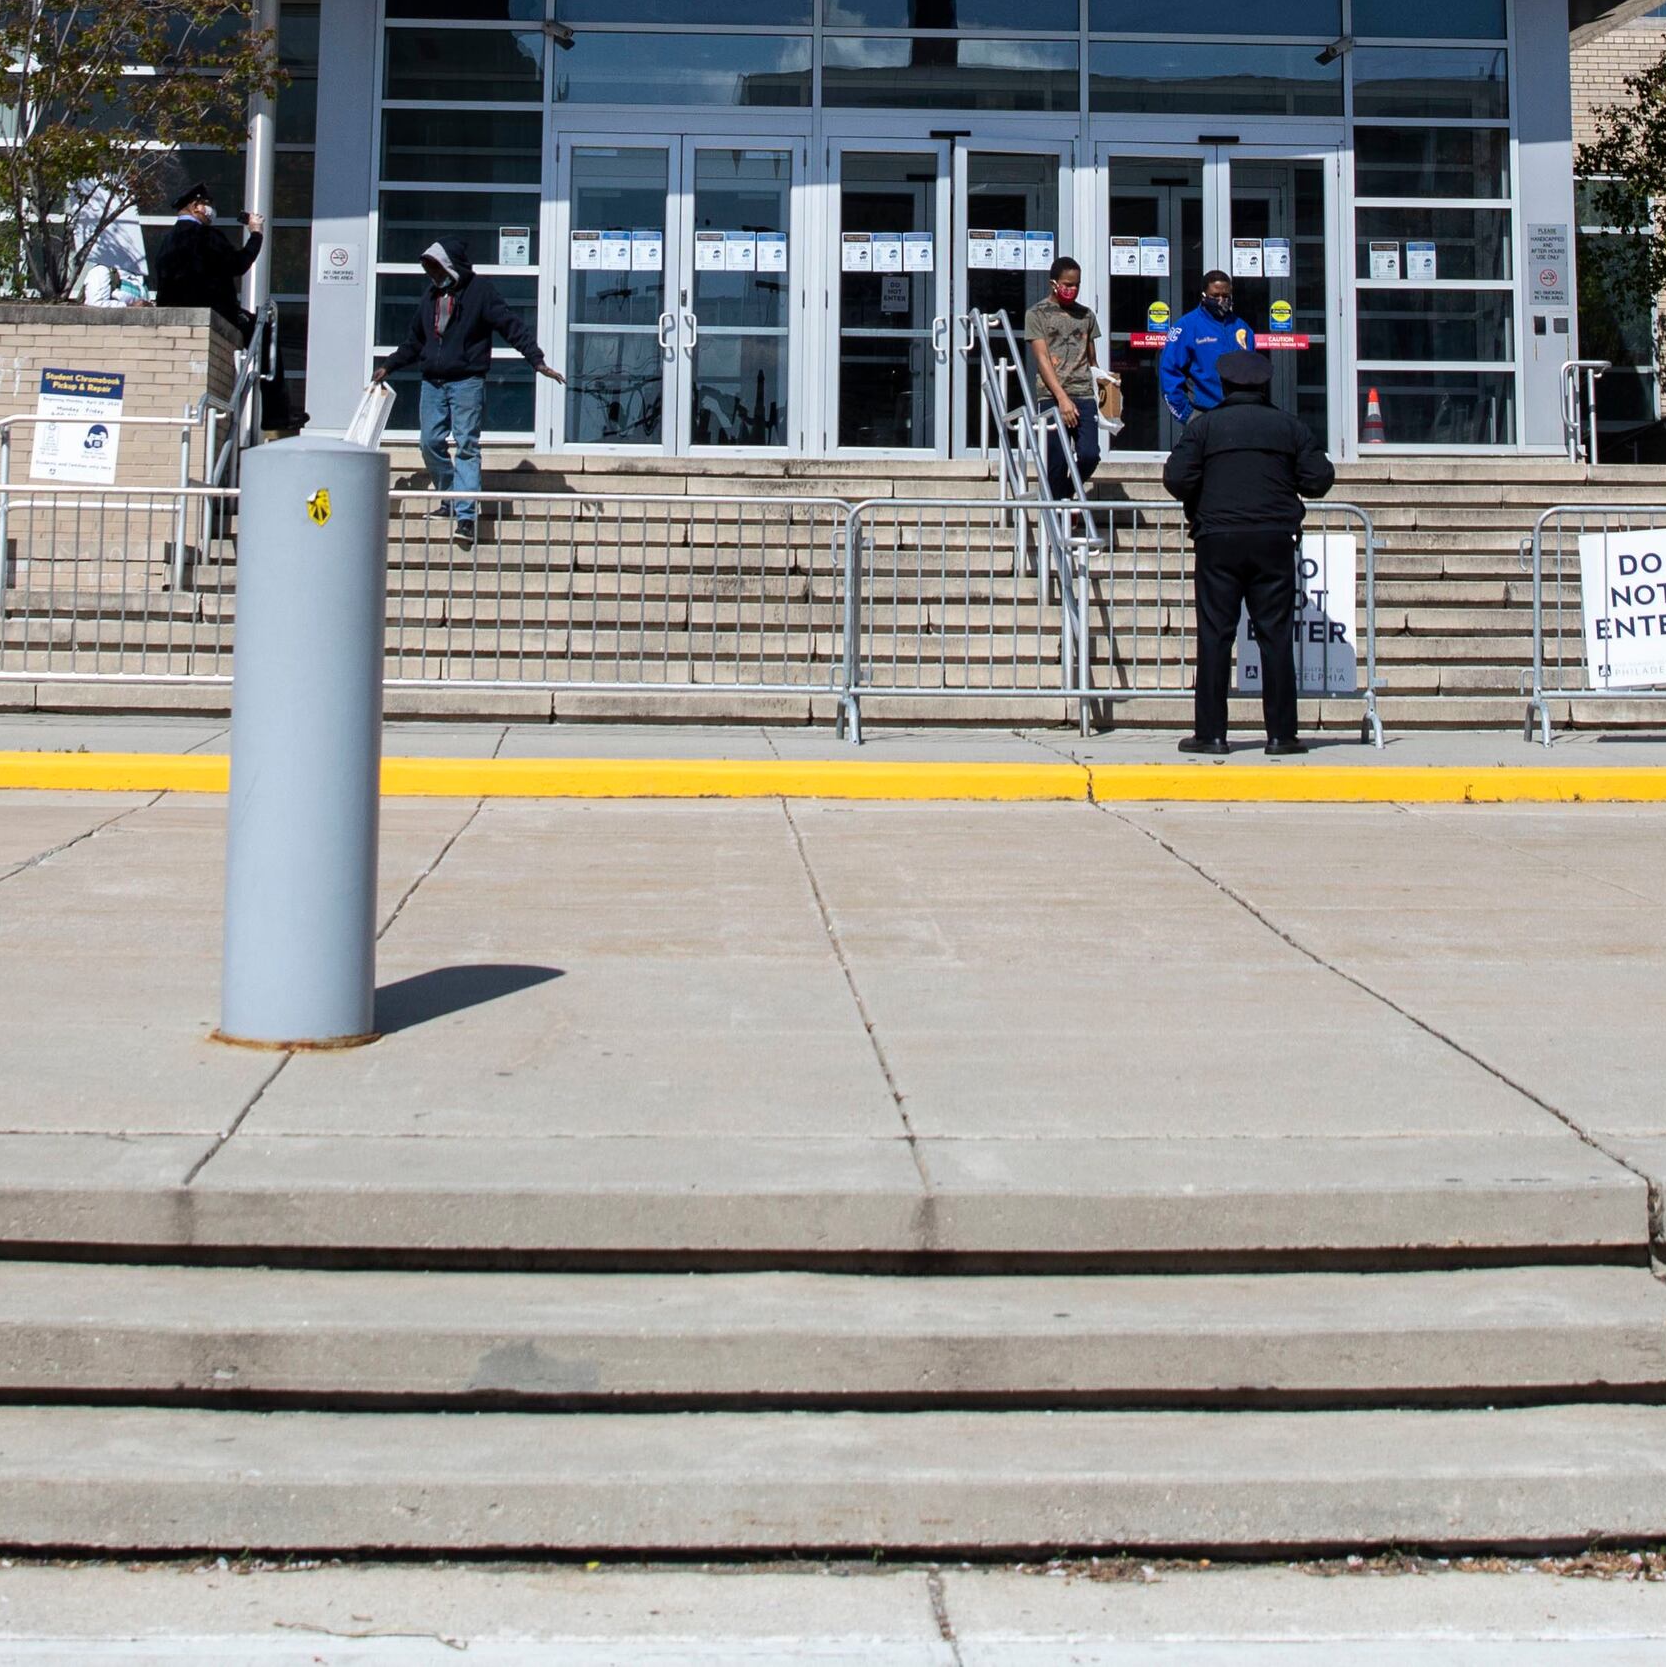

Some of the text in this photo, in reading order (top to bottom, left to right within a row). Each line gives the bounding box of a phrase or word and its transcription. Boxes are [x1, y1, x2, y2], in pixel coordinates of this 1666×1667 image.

[45, 372, 121, 385] Student Chromebook
[52, 381, 77, 391] Pickup
[87, 384, 112, 393] Repair
[1298, 558, 1318, 579] O
[1619, 552, 1663, 576] DO
[1296, 589, 1329, 612] OT
[1247, 620, 1347, 644] ETER
